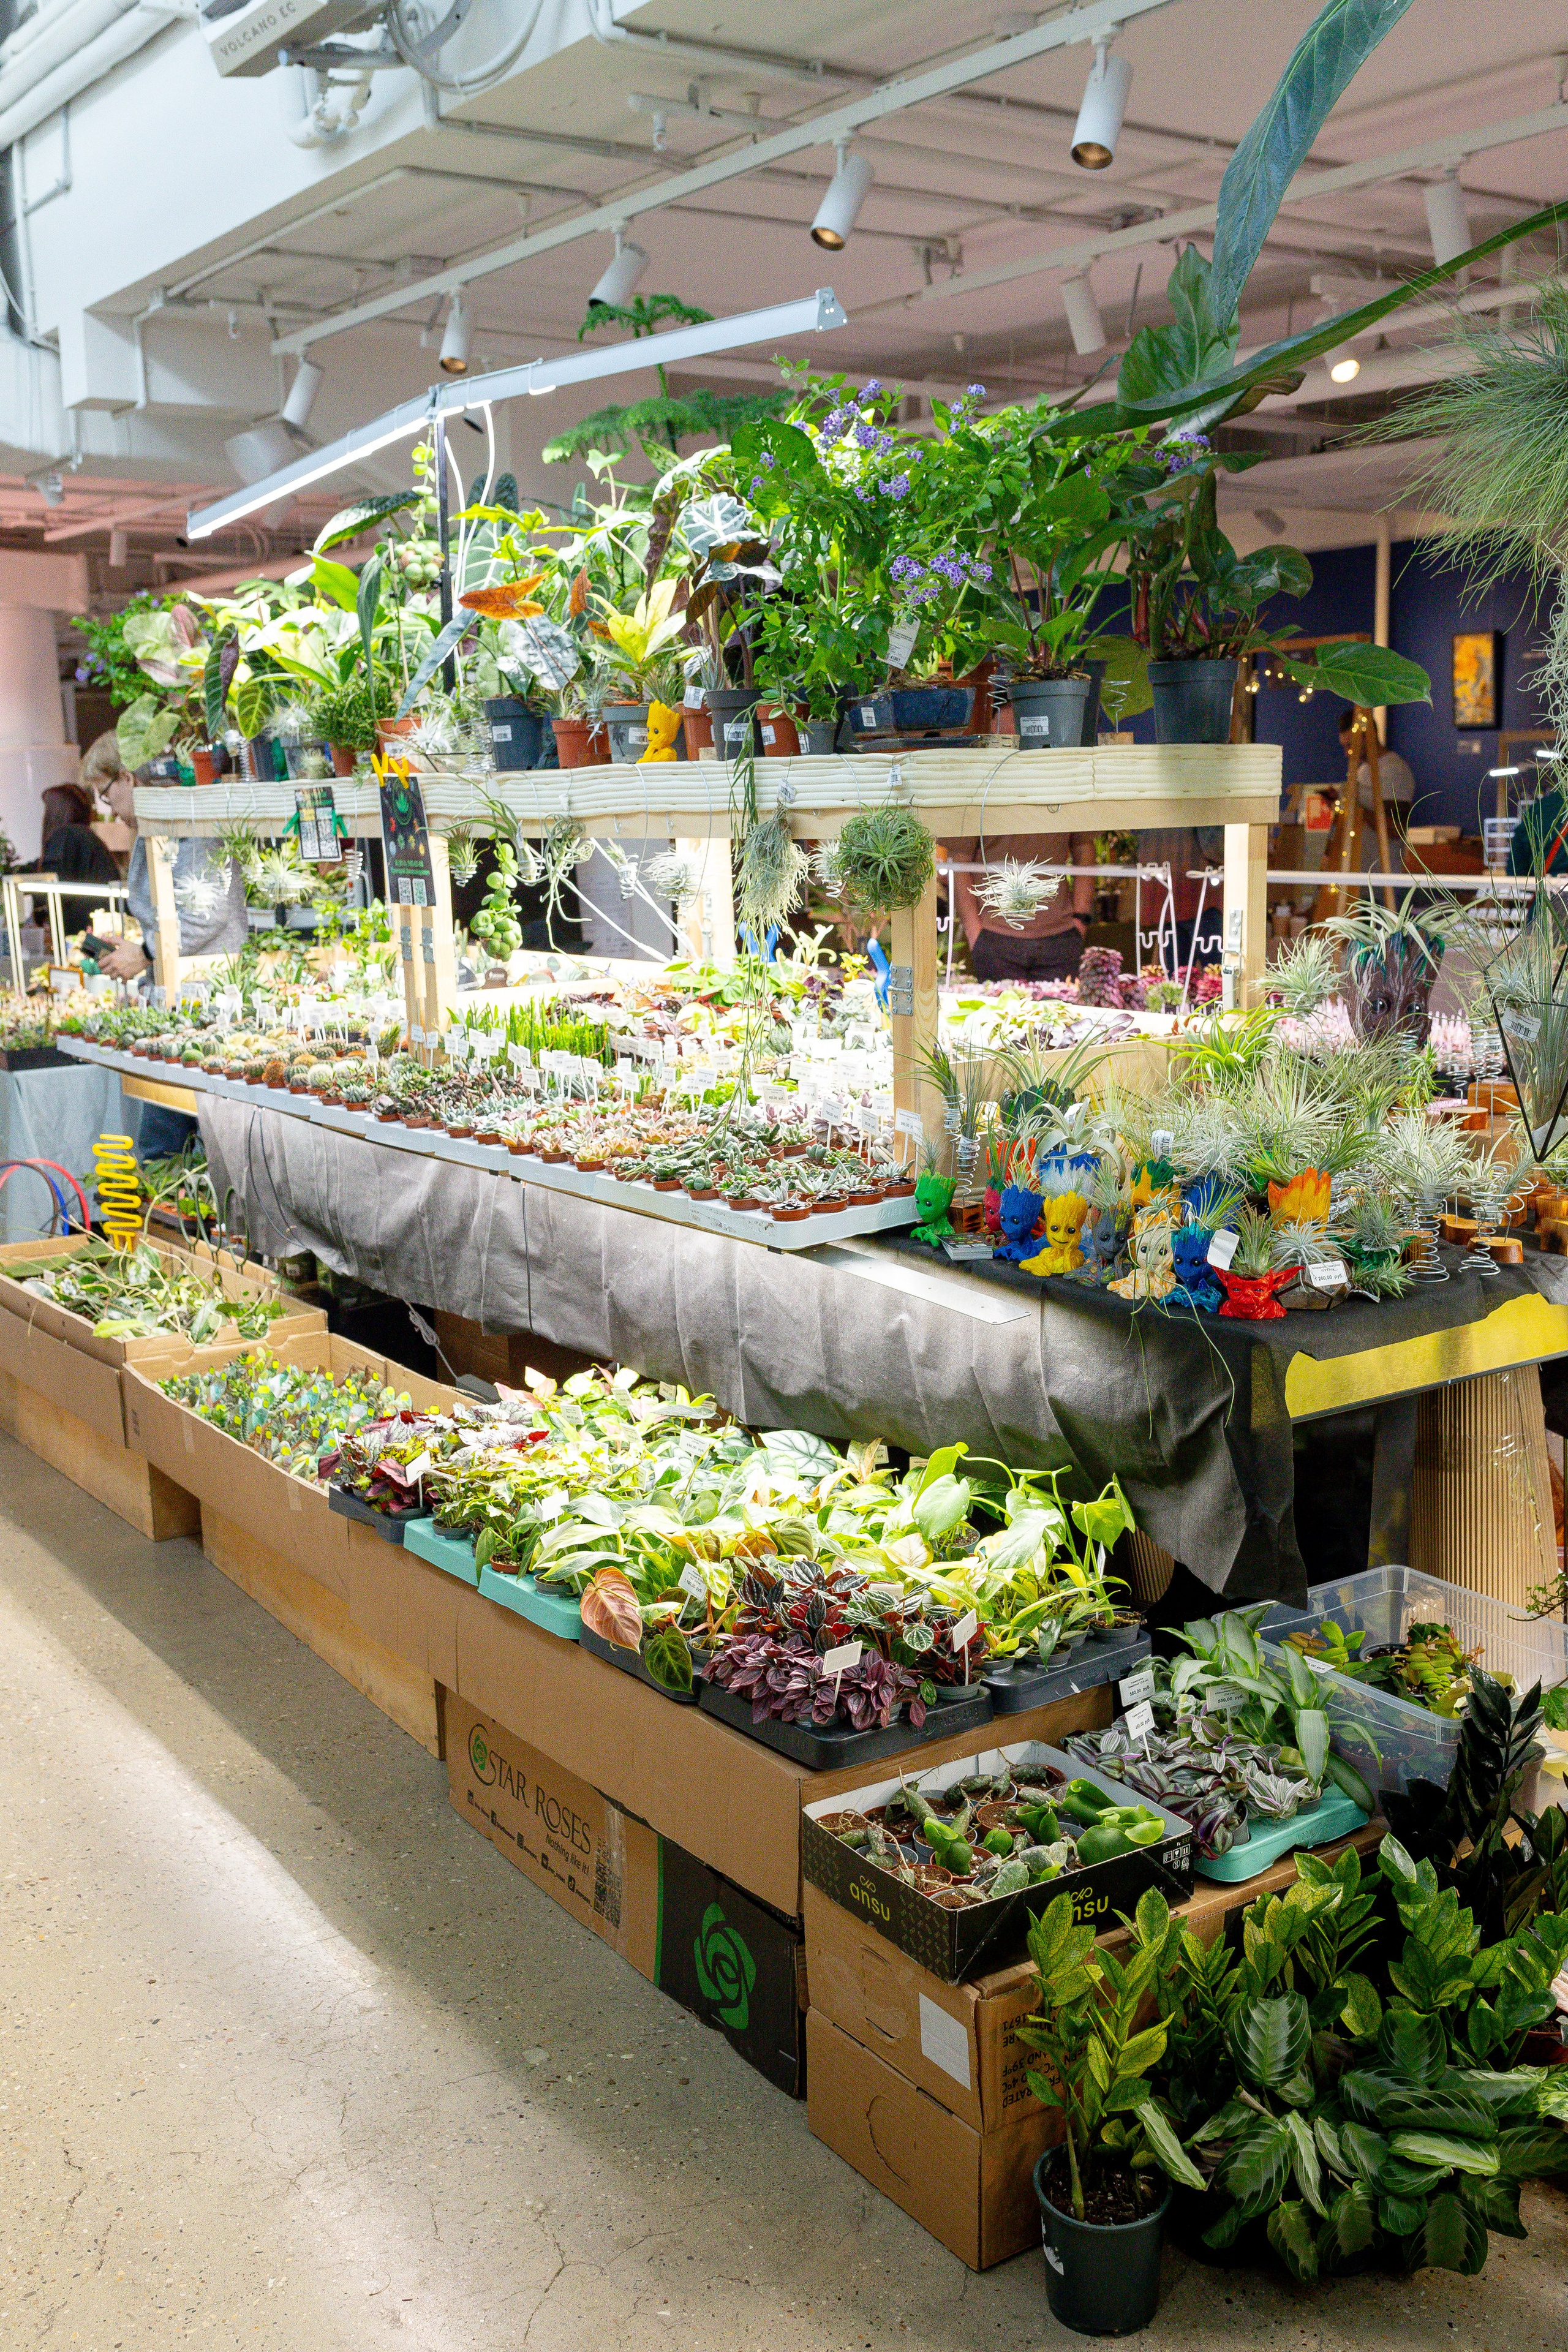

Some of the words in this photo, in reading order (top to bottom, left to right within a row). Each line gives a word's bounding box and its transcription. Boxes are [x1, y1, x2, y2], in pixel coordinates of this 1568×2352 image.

[220, 15, 276, 55] VOLCANO
[279, 1, 296, 18] EC
[535, 1784, 590, 1855] ROSES
[545, 1833, 570, 1862] Nothing
[570, 1853, 581, 1870] like
[850, 1882, 890, 1921] ansu
[1073, 1896, 1109, 1921] nsu
